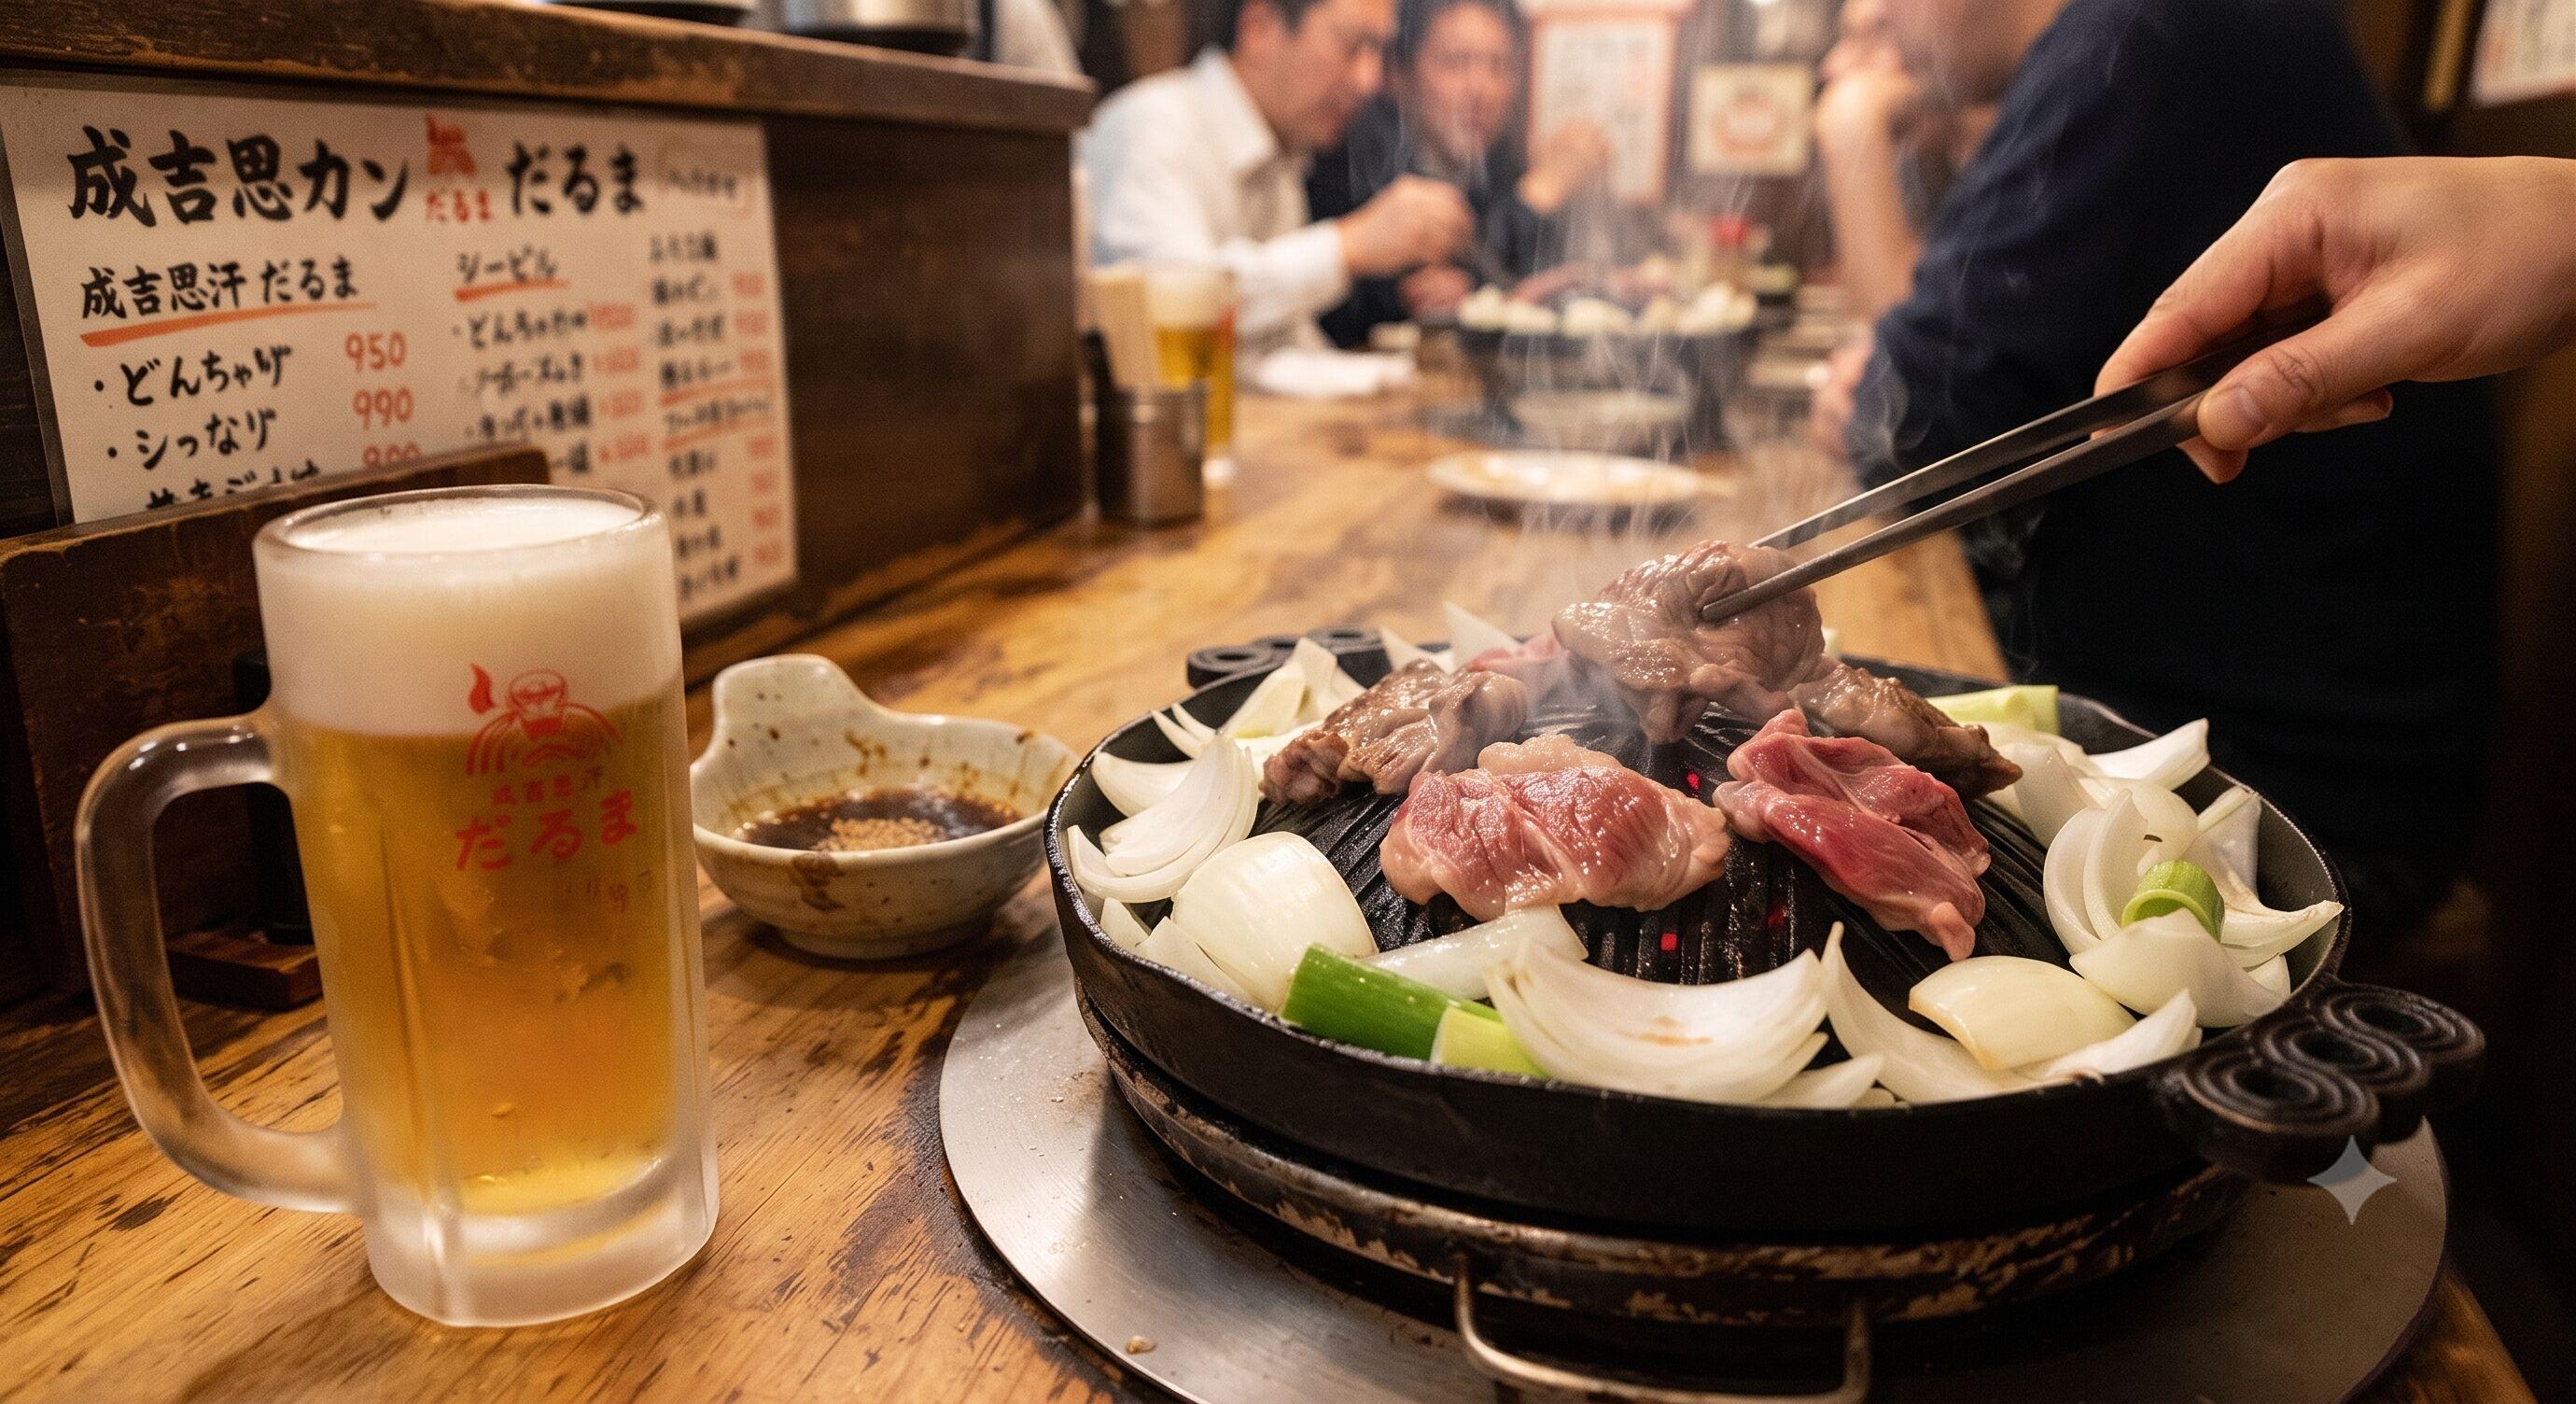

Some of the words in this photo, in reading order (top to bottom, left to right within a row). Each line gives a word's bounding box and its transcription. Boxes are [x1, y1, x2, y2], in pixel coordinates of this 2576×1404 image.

[66, 125, 409, 227] 成吉思カン
[504, 140, 645, 218] だるま
[80, 261, 247, 319] 成吉思汗
[259, 254, 358, 304] だるま
[344, 330, 408, 372] 950
[352, 386, 415, 430] 990
[454, 789, 638, 872] だるま
